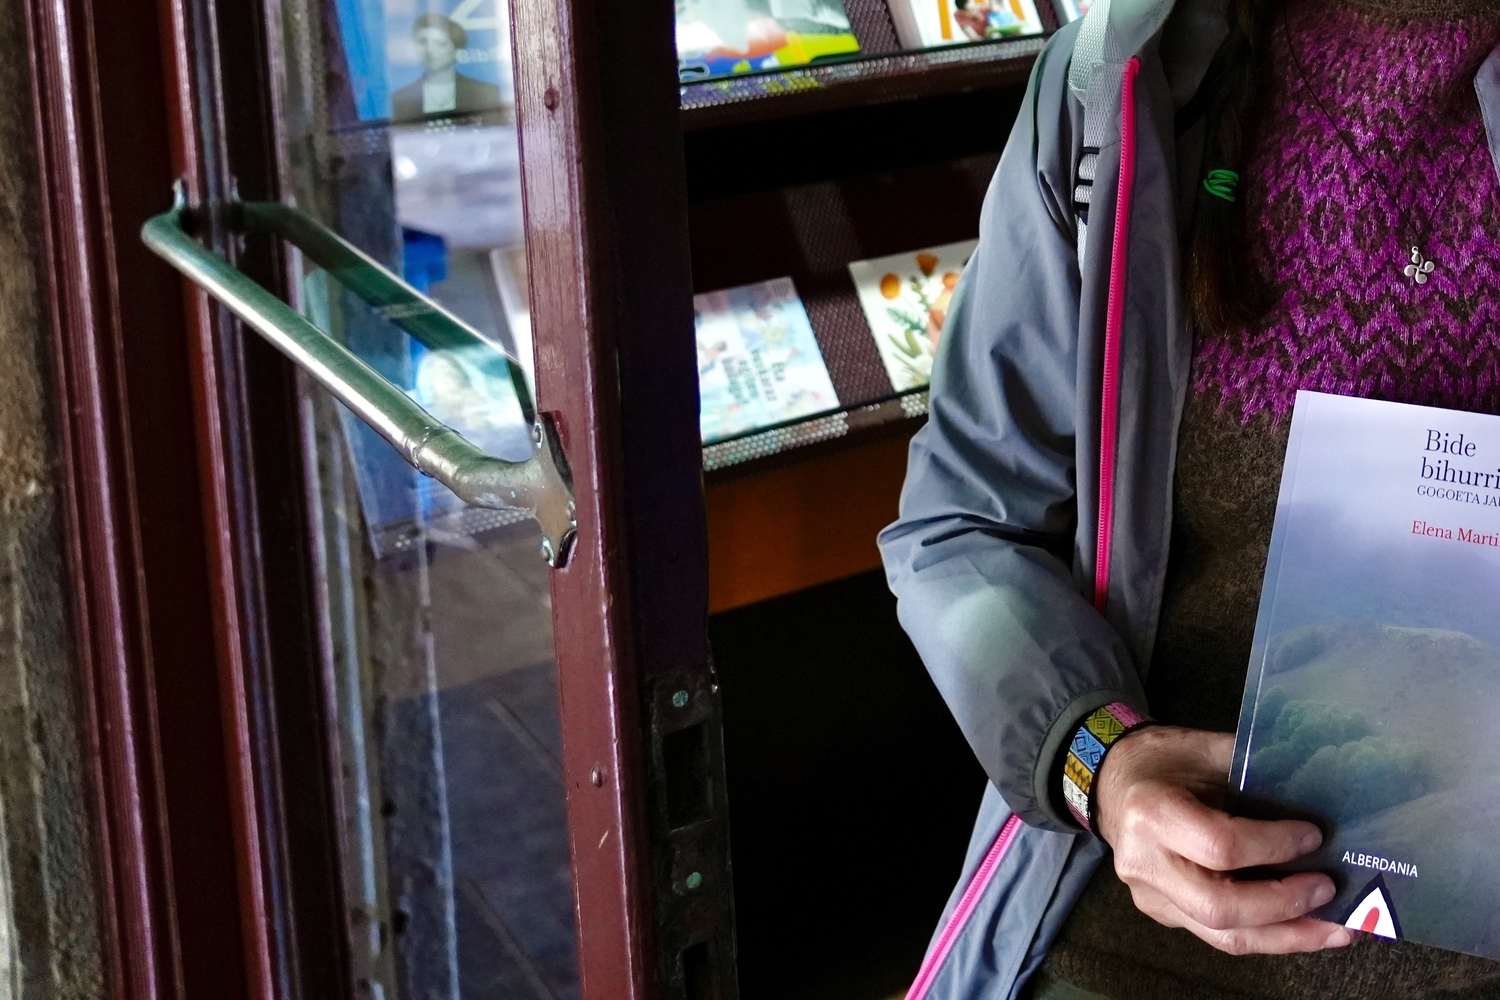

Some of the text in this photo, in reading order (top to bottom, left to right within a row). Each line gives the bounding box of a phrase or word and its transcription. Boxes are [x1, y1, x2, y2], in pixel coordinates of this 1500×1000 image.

[1423, 428, 1477, 458] Bide
[1416, 484, 1481, 505] GOGOETA
[1411, 519, 1453, 540] Elena
[1341, 850, 1419, 878] ALBERDANIA
